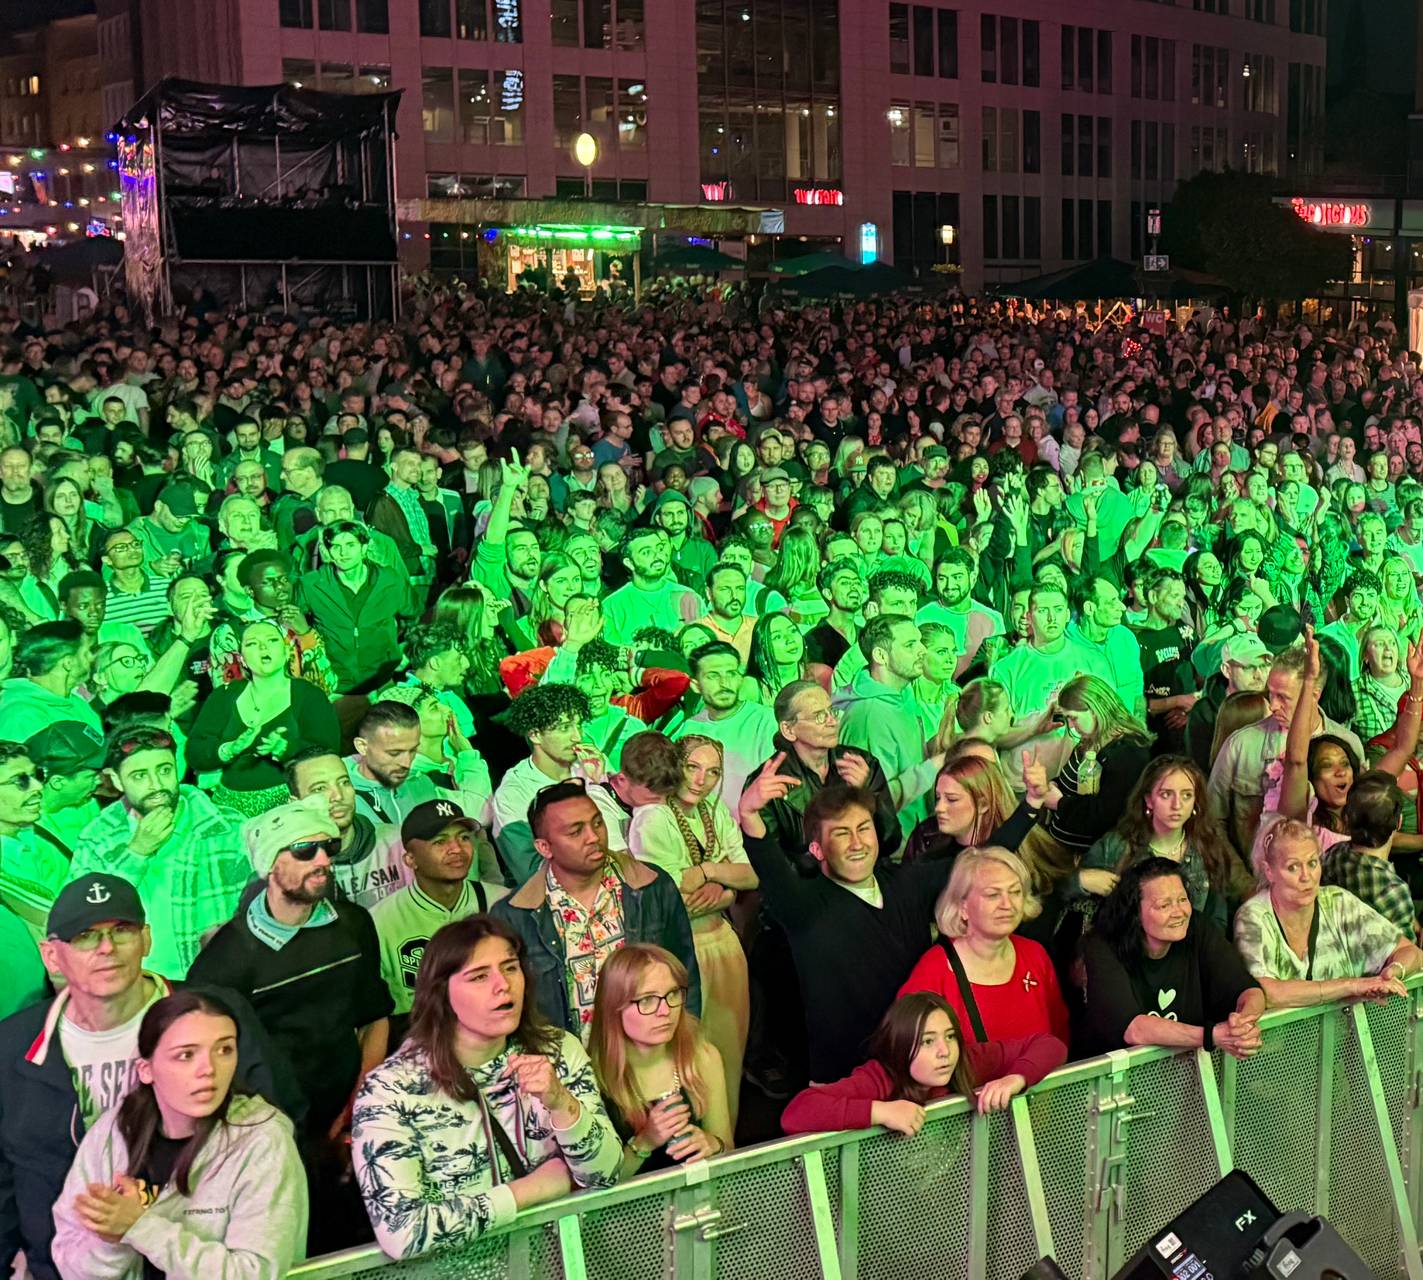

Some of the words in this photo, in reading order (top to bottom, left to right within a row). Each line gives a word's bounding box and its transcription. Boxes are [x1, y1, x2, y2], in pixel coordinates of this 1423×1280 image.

[1145, 313, 1164, 323] WC
[436, 802, 454, 816] NY
[1235, 1209, 1257, 1232] FX
